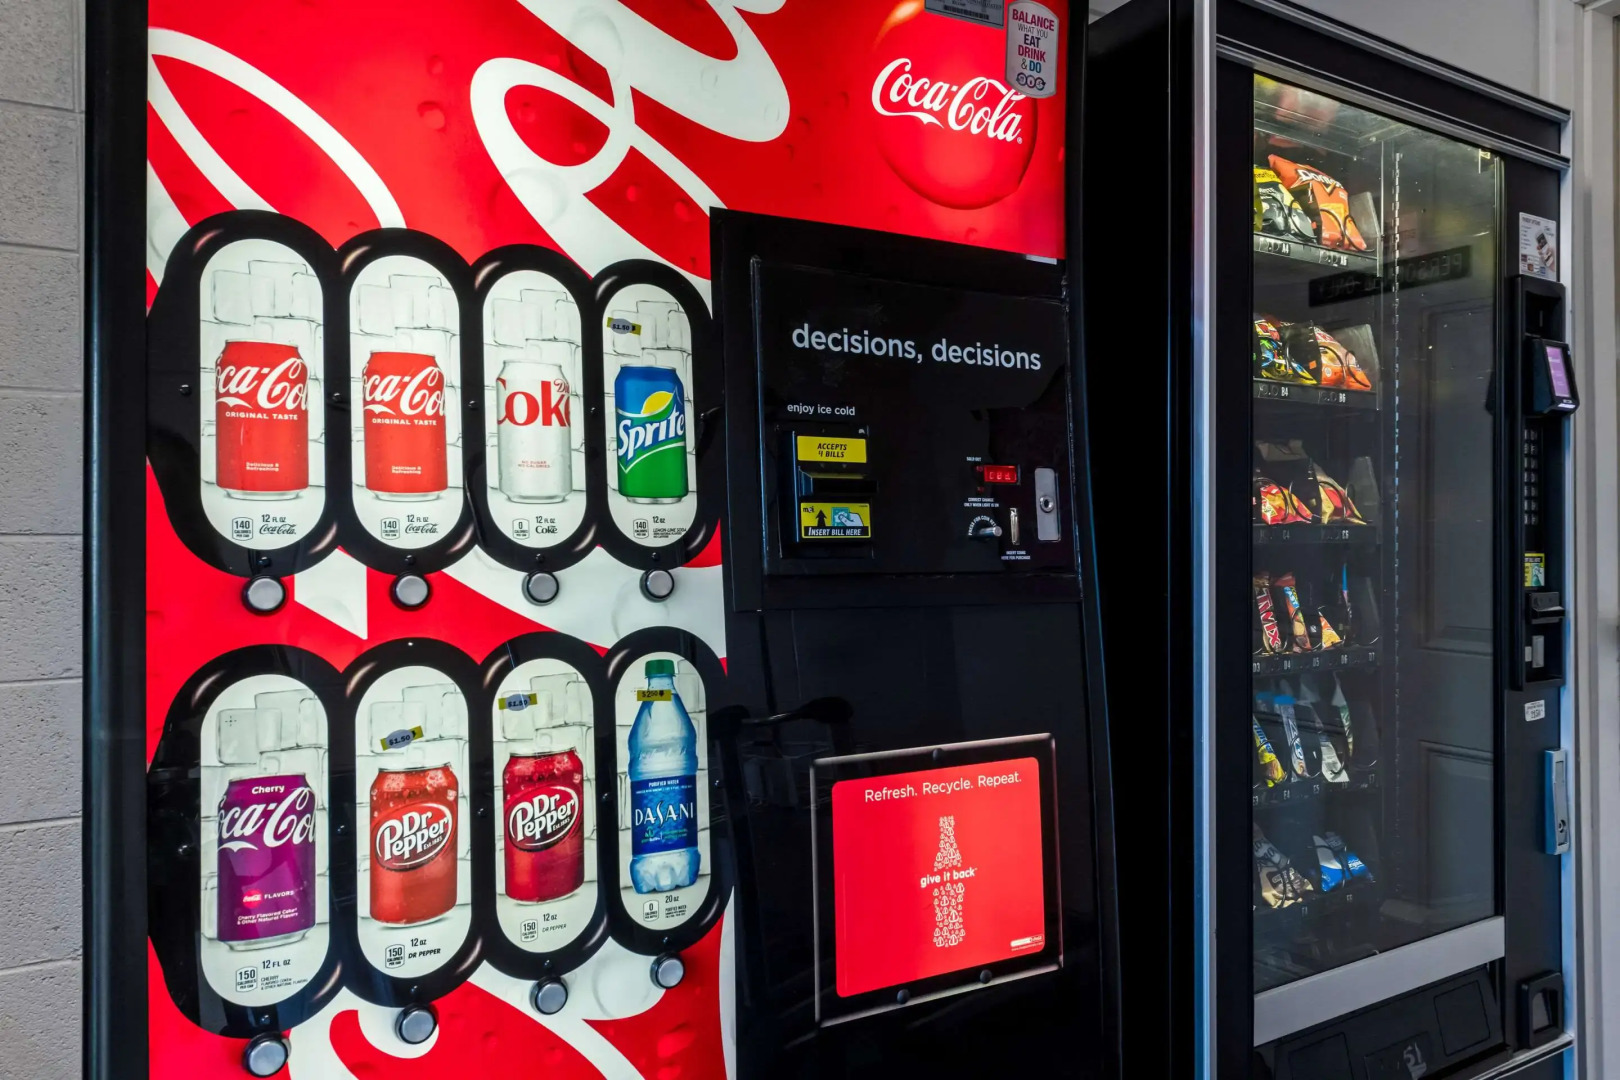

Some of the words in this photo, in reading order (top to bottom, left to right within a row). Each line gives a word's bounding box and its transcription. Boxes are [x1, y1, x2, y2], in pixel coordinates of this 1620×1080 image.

[1012, 8, 1054, 31] BALANCE
[1017, 23, 1034, 37] WHAT
[1035, 28, 1048, 38] YOU
[1023, 34, 1041, 48] EAT
[1018, 45, 1046, 62] DRINK
[1021, 58, 1028, 71] &
[1029, 60, 1042, 73] DO
[871, 57, 1026, 144] Coca-Cola
[792, 323, 923, 364] decisions,
[931, 338, 1042, 371] decisions
[787, 403, 814, 415] enjoy
[817, 403, 832, 414] ice
[834, 406, 855, 416] cold
[225, 411, 269, 420] ORIGINAL
[618, 403, 684, 461] Sprite
[817, 443, 847, 451] ACCEPTS
[261, 513, 271, 523] 12
[406, 514, 415, 522] 12
[535, 515, 543, 523] 12
[652, 515, 659, 524] 12
[234, 520, 250, 529] 140
[259, 523, 297, 535] Coca-Cola
[383, 520, 397, 529] 140
[405, 523, 439, 534] Coca-Cola
[518, 521, 523, 530] 0
[535, 525, 558, 534] Coke
[635, 521, 646, 529] 140
[808, 527, 830, 536] INSERT
[831, 528, 845, 536] BILL
[845, 528, 861, 536] HERE
[1257, 587, 1281, 649] TWIX
[388, 734, 411, 746] $1.50
[251, 785, 285, 795] Cherry
[865, 784, 918, 803] Refresh.
[922, 778, 974, 796] Recycle.
[977, 771, 1022, 788] Repeat.
[532, 793, 561, 819] Dr
[635, 801, 693, 827] DASANI
[402, 811, 432, 837] Dr
[516, 799, 575, 842] Pepper
[383, 818, 448, 861] Pepper
[920, 873, 941, 888] give
[943, 869, 951, 881] it
[953, 867, 975, 881] back
[264, 890, 294, 899] FLAVORS
[665, 894, 672, 904] 20
[649, 903, 654, 911] 0
[543, 913, 550, 922] 12
[523, 921, 536, 932] 150
[550, 923, 567, 931] PEPPER
[410, 938, 419, 947] 12
[388, 946, 403, 957] 150
[418, 948, 441, 957] PEPPER
[262, 959, 271, 969] 12
[238, 969, 256, 980] 150
